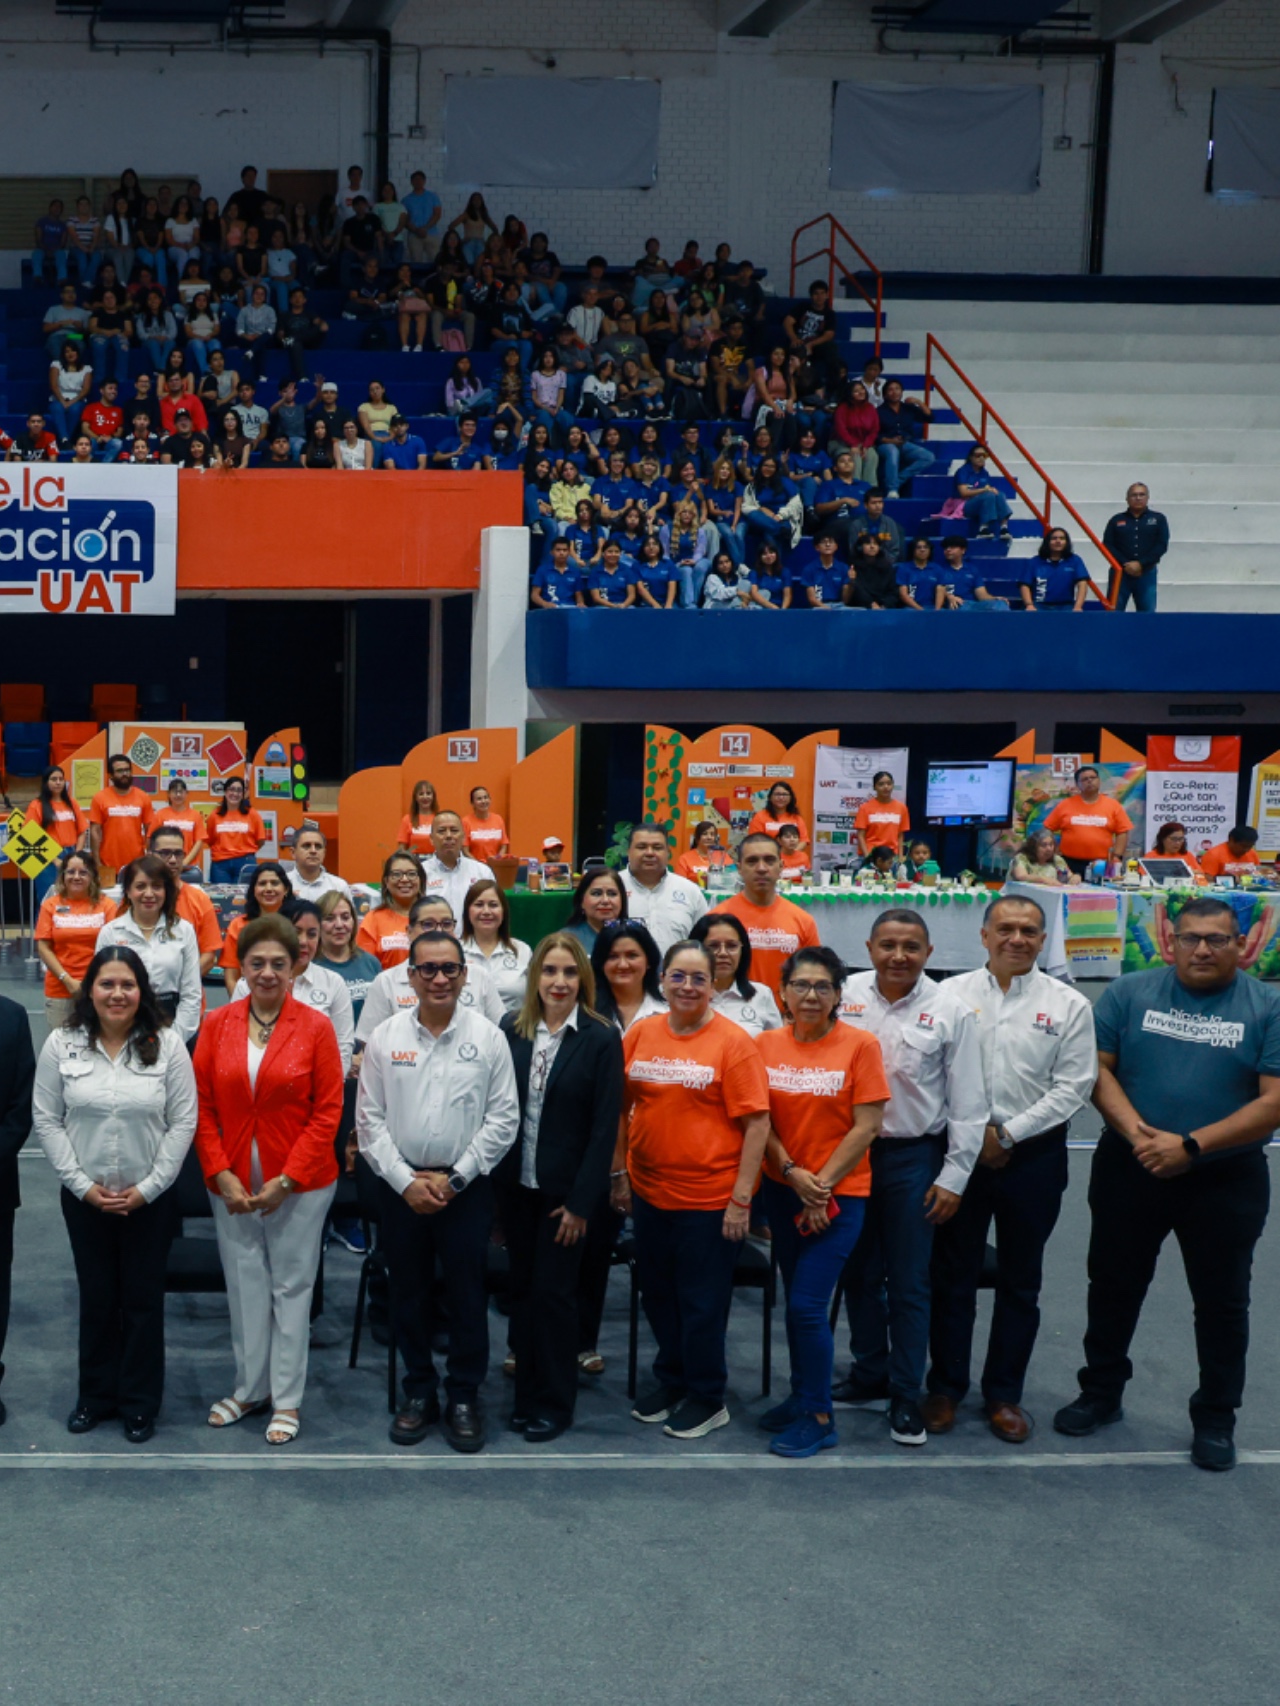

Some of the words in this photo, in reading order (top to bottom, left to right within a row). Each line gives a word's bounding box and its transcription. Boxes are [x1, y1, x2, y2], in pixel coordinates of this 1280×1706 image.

[23, 467, 65, 508] la
[40, 573, 141, 613] UAT
[179, 737, 196, 753] 12
[455, 741, 472, 756] 13
[728, 736, 744, 752] 14
[1060, 757, 1075, 773] 15
[1163, 780, 1219, 790] Eco-Reto:
[1197, 792, 1217, 801] tan
[1154, 803, 1226, 813] responsable
[1153, 814, 1178, 822] eres
[1180, 814, 1226, 823] cuando
[1147, 1014, 1241, 1038] Investigación
[1210, 1038, 1238, 1048] UAT
[391, 1050, 418, 1061] UAT
